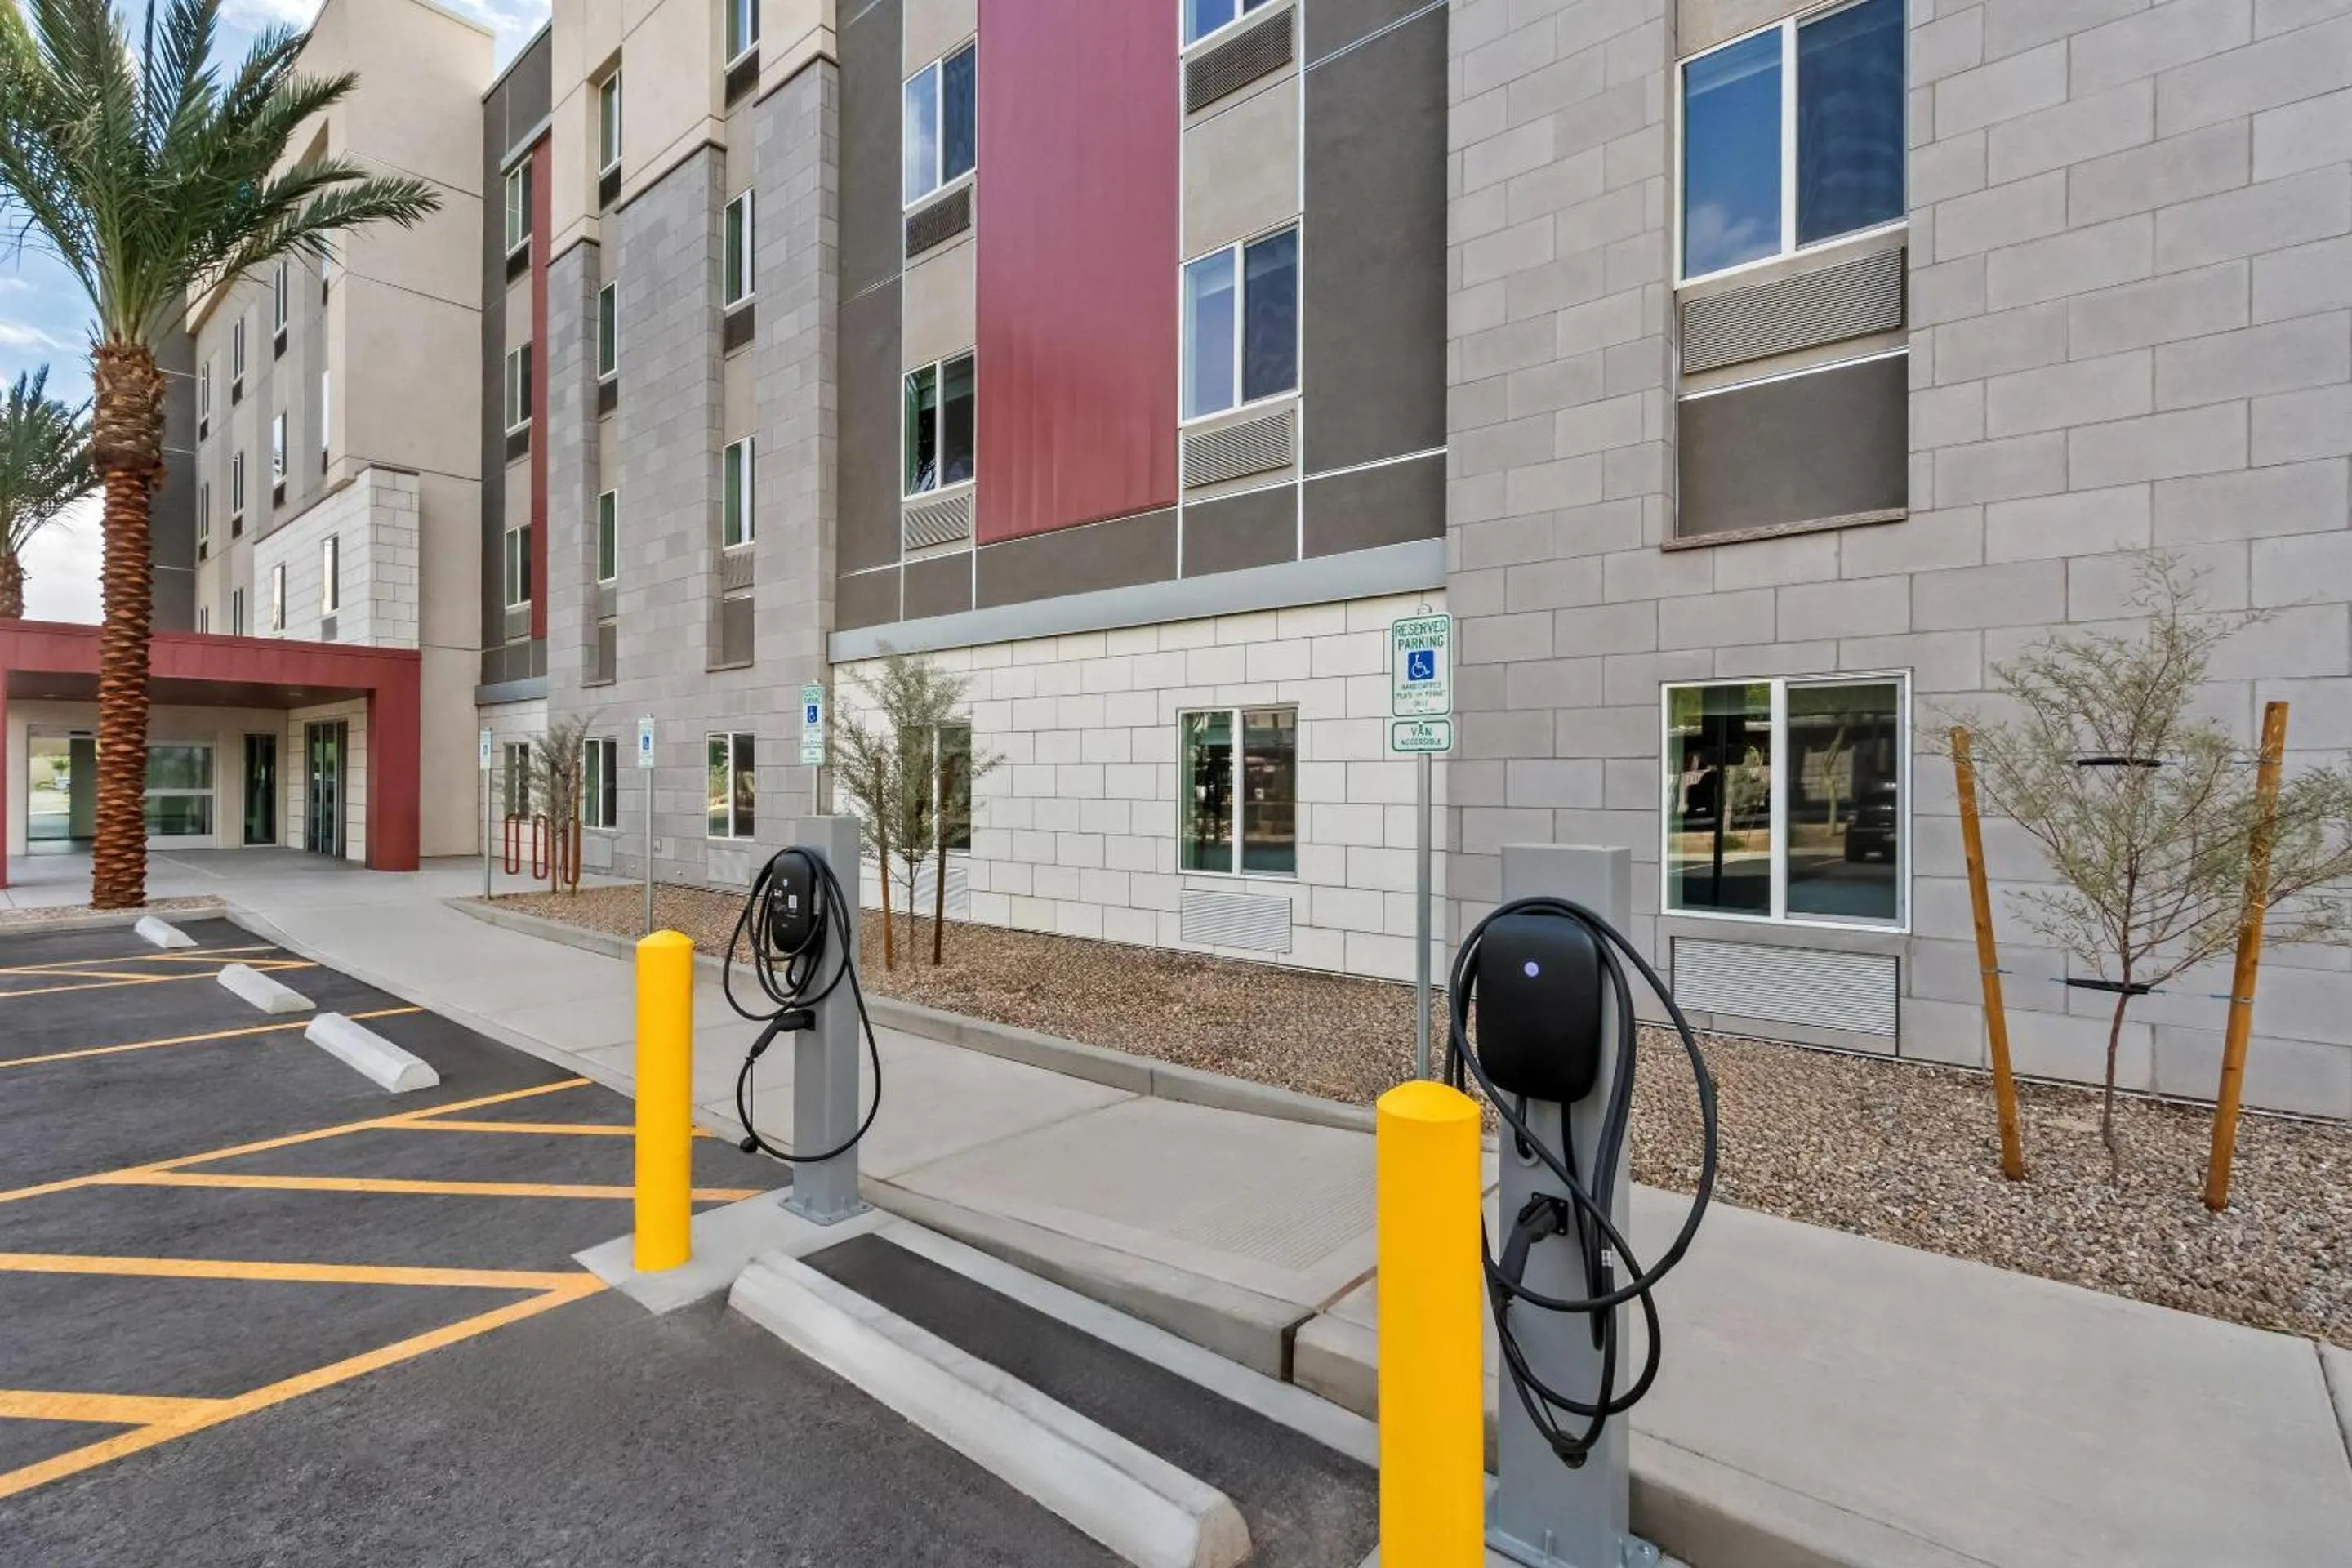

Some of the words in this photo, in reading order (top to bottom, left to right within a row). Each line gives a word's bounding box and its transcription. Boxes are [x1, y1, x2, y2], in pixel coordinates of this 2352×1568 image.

[1395, 621, 1446, 638] RESERVED
[1397, 635, 1445, 651] PARKING
[1410, 727, 1432, 737] VAN
